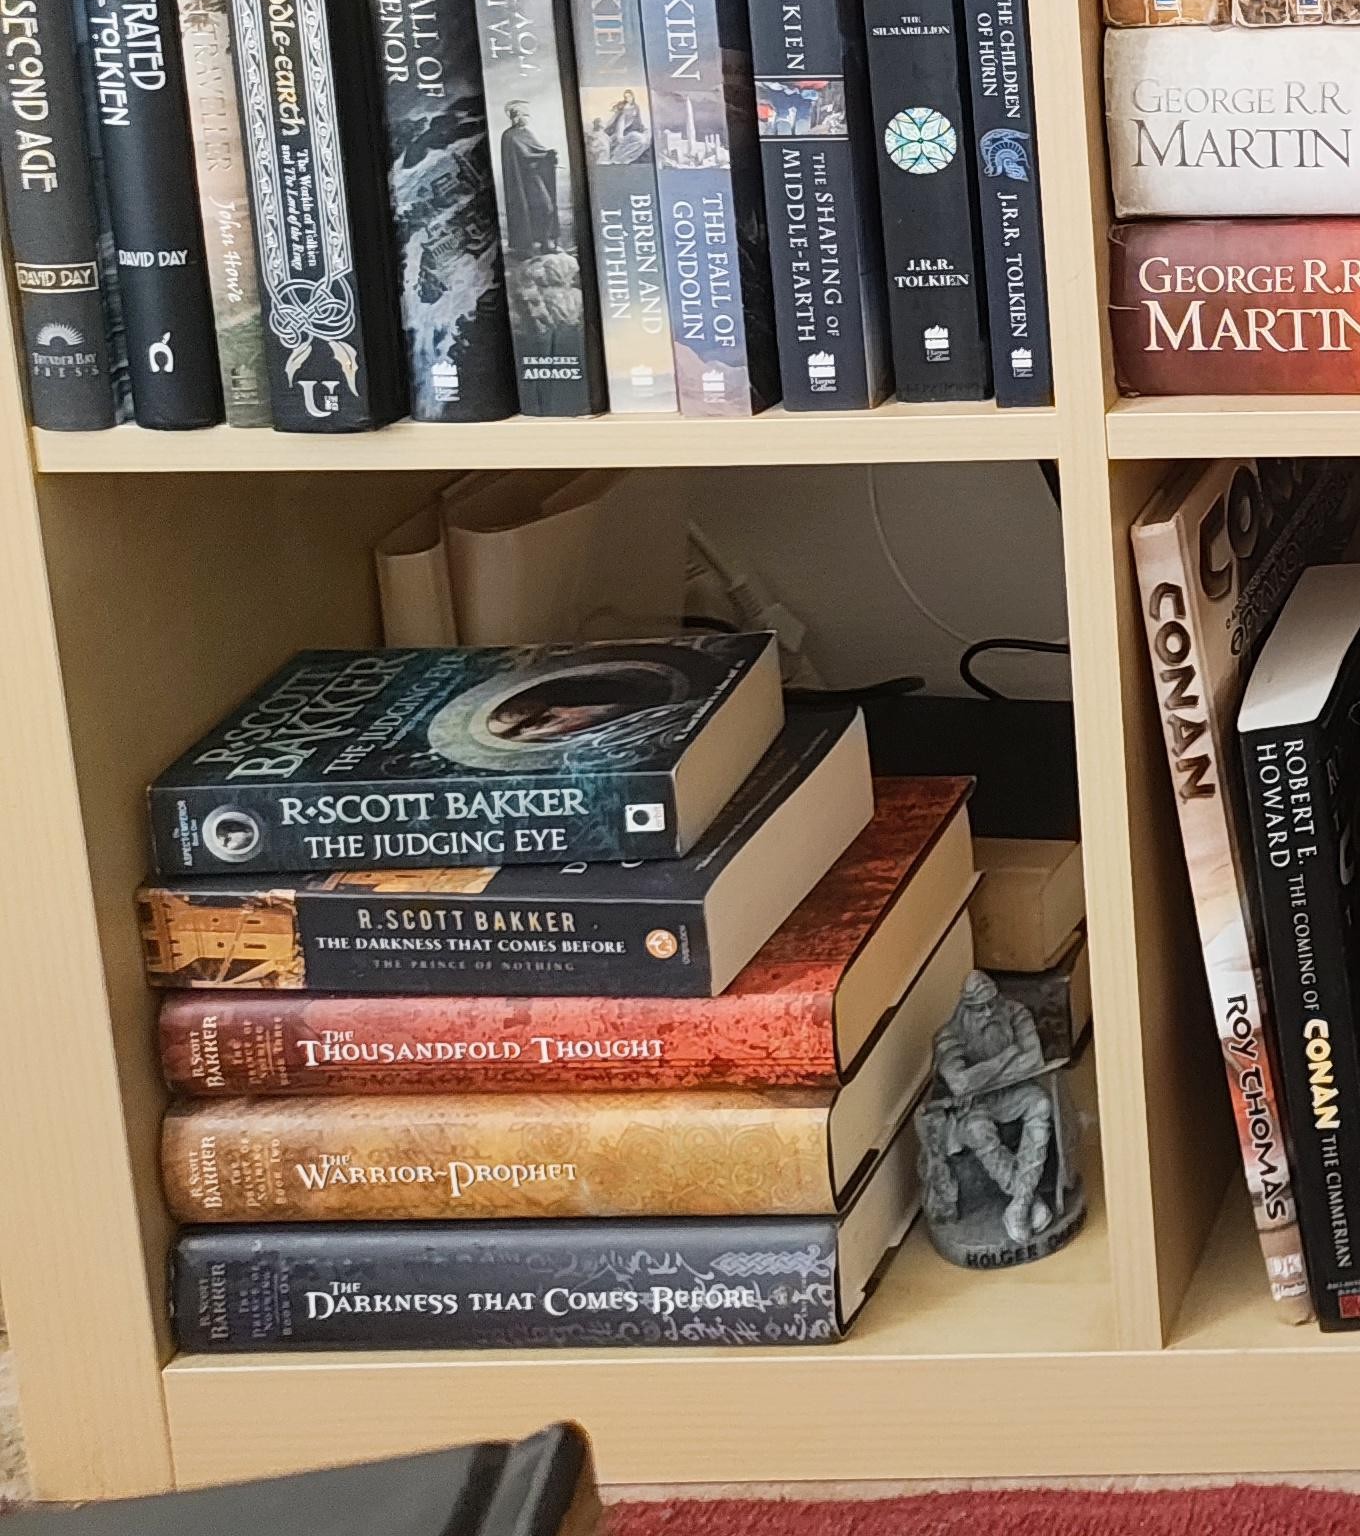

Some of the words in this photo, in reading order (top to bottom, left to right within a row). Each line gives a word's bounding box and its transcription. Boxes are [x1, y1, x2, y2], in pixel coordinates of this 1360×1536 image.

[2, 1, 49, 121] SECOND
[90, 11, 130, 126] TOLKIEN
[996, 28, 1021, 119] CHILDREN
[1132, 78, 1276, 115] GEORGE
[17, 130, 56, 193] AGE
[1132, 120, 1351, 168] MARTIN
[208, 198, 235, 248] John
[629, 194, 658, 275] BEREN
[702, 193, 725, 246] THE
[782, 149, 816, 342] MIDDLE-EARTH
[815, 190, 844, 306] SHAPING
[119, 250, 155, 267] DAVID
[157, 249, 189, 265] DAY
[601, 209, 631, 320] LÚTHIEN
[672, 200, 704, 340] GONDOLIN
[706, 251, 731, 311] FALL
[894, 273, 970, 287] TOLKIEN
[906, 259, 954, 272] J.R.R.
[1139, 256, 1295, 295] GEORGE
[639, 278, 664, 335] AND
[1002, 253, 1028, 338] TOLKIEN
[712, 315, 735, 348] OF
[1149, 582, 1216, 804] CONAN
[445, 788, 589, 821] BAKKER
[1256, 743, 1291, 870] HOWARD
[1283, 738, 1318, 837] ROBERT
[304, 835, 365, 859] THE
[374, 830, 506, 857] JUDGING
[515, 828, 569, 851] EYE
[354, 936, 444, 952] DARKNESS
[448, 937, 492, 952] THAT
[495, 938, 556, 953] COMES
[561, 938, 626, 954] BEFORE
[1292, 912, 1317, 987] COMING
[297, 1038, 522, 1067] THOUSANDFOLD
[530, 1035, 664, 1064] THOUGHT
[1227, 993, 1258, 1060] ROY
[1303, 1018, 1340, 1130] CONAN
[1240, 1064, 1289, 1222] THOMAS
[1321, 1170, 1353, 1268] CIMMERIAN
